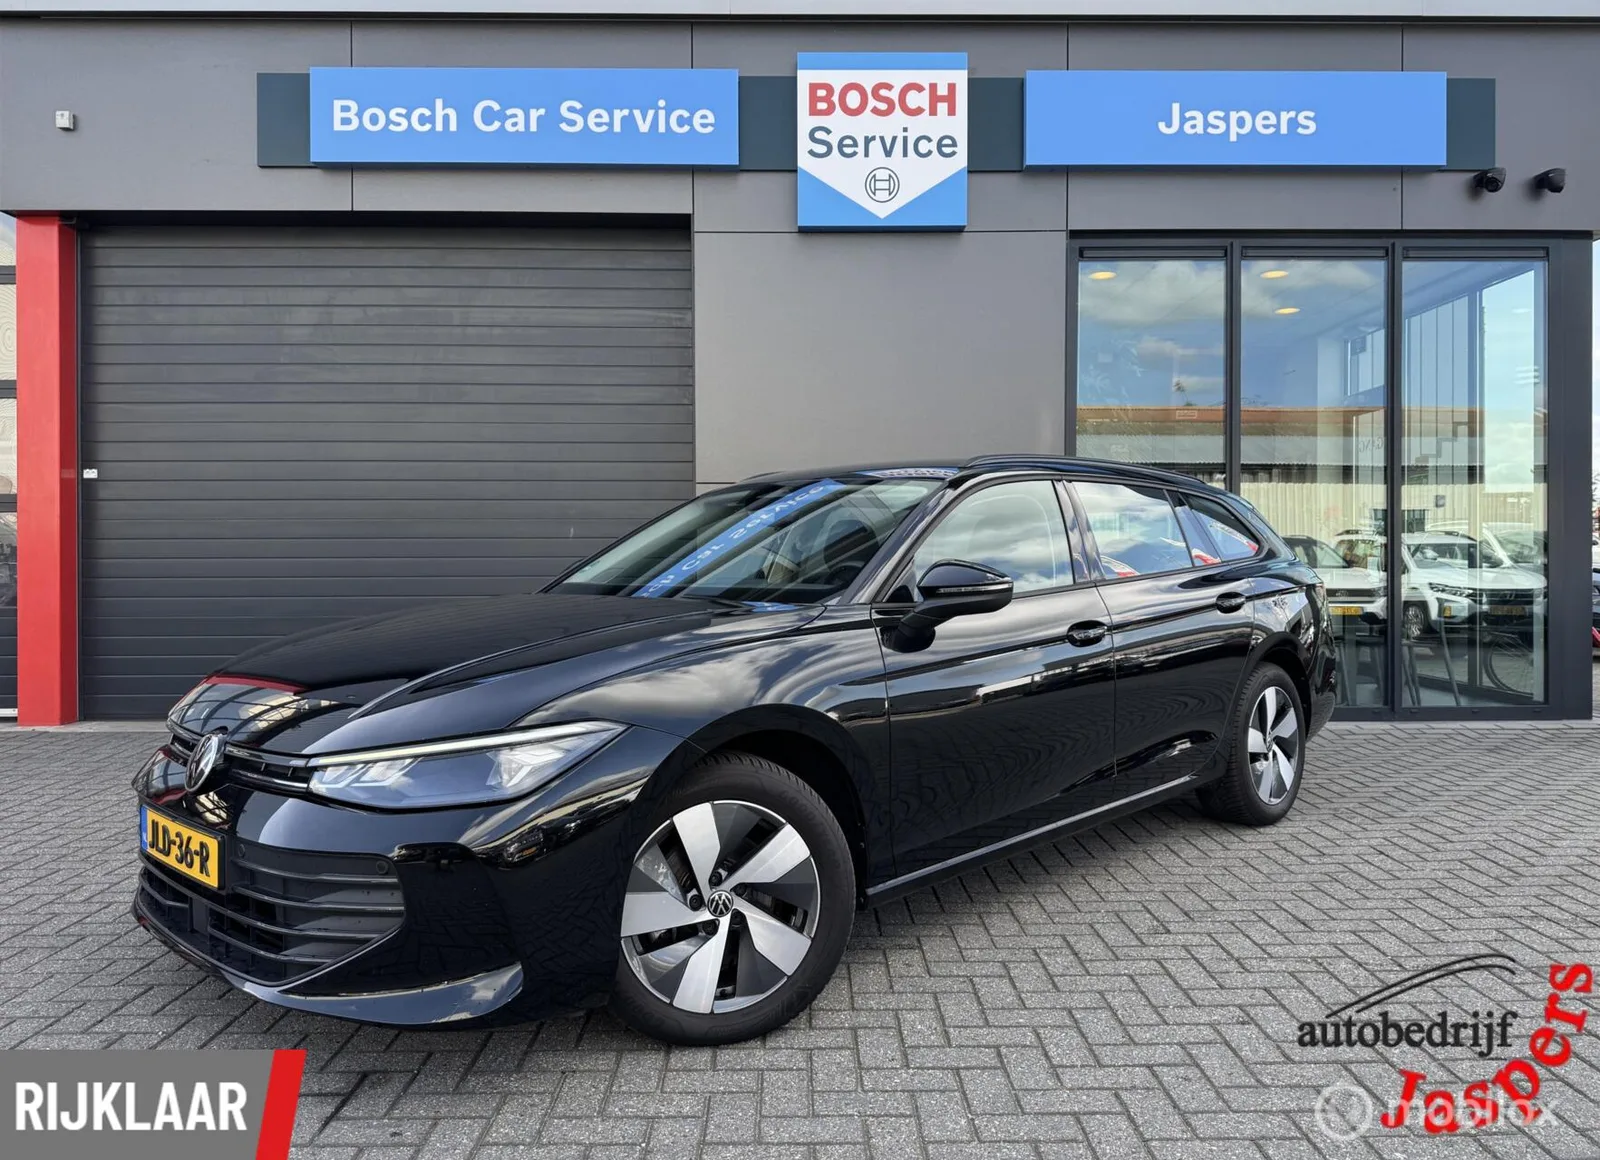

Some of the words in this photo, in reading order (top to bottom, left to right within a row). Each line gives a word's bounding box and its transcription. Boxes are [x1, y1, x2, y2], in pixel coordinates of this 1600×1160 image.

[333, 98, 457, 132] Bosch
[473, 99, 546, 132] Car
[559, 99, 715, 134] Service
[808, 82, 956, 117] BOSCH
[1158, 102, 1317, 142] Jaspers
[807, 125, 958, 159] Service
[148, 819, 211, 877] JLD-36-R
